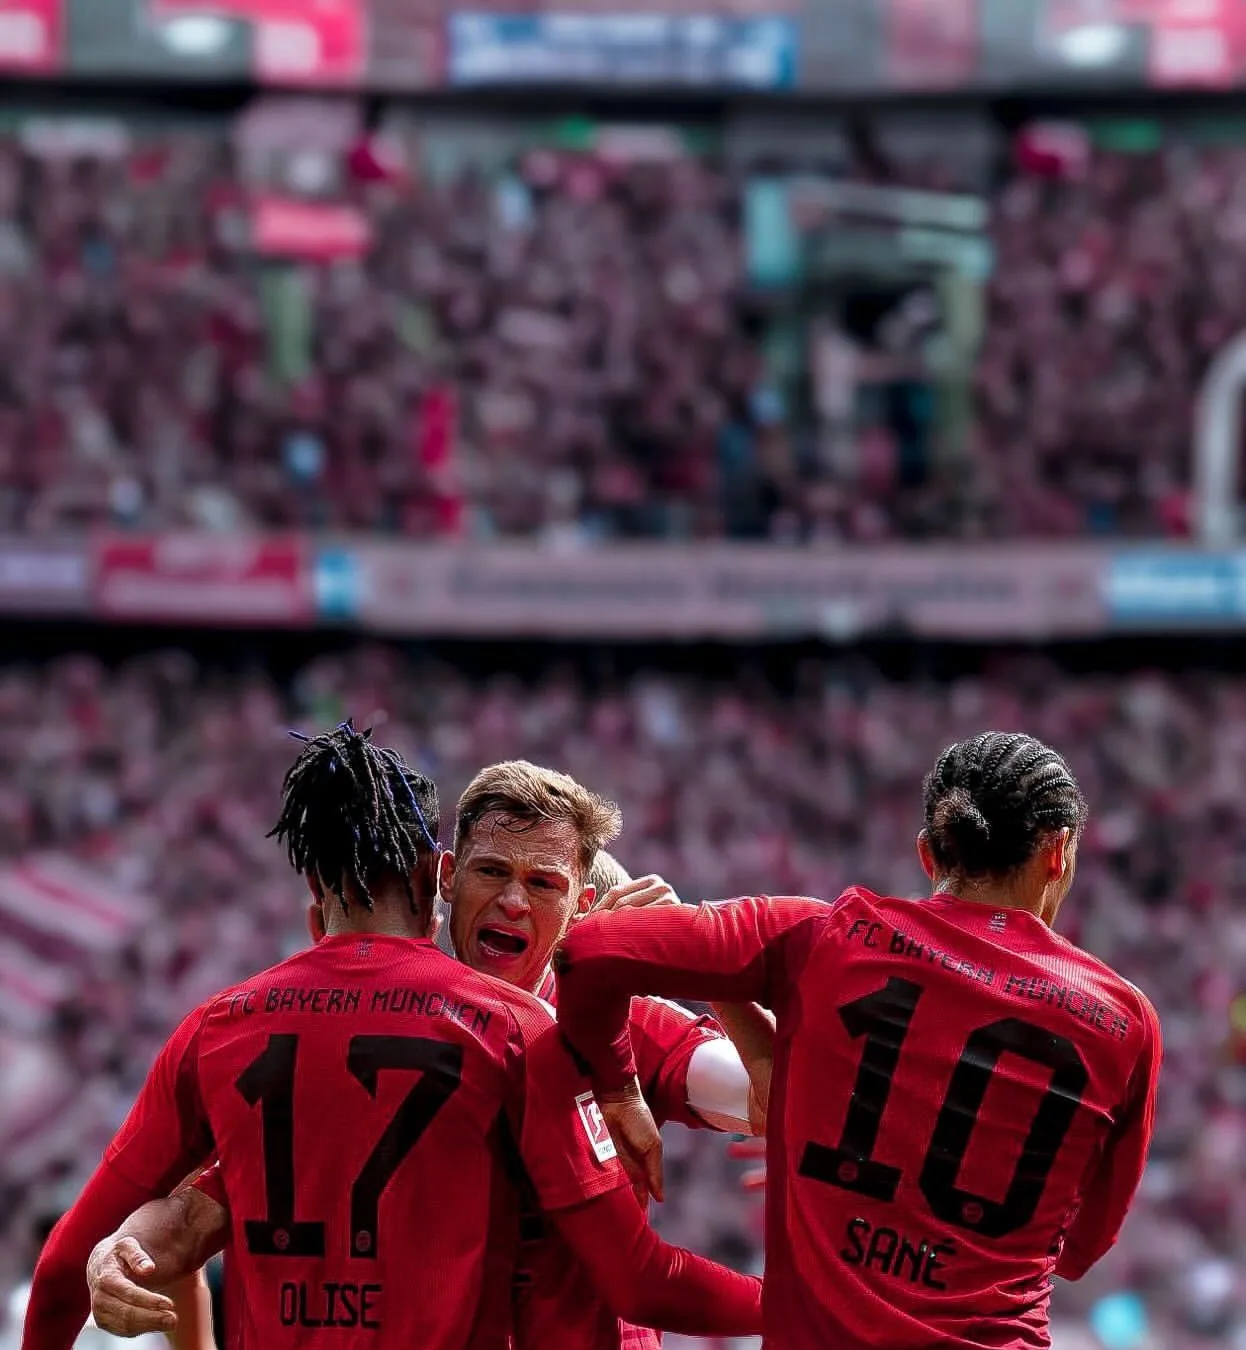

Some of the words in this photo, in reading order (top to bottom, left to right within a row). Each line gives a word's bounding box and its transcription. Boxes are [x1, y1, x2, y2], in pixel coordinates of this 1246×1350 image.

[228, 989, 257, 1017] FC
[265, 987, 361, 1014] BAYERN
[370, 987, 493, 1033] MÜNCHEN
[848, 919, 884, 947] FC
[889, 929, 993, 986] BAYERN
[1004, 974, 1129, 1040] MÜNCHEN
[235, 1033, 463, 1258] 17
[799, 978, 1089, 1238] 10
[842, 1218, 957, 1291] SANÉ
[280, 1282, 383, 1329] OLISE
